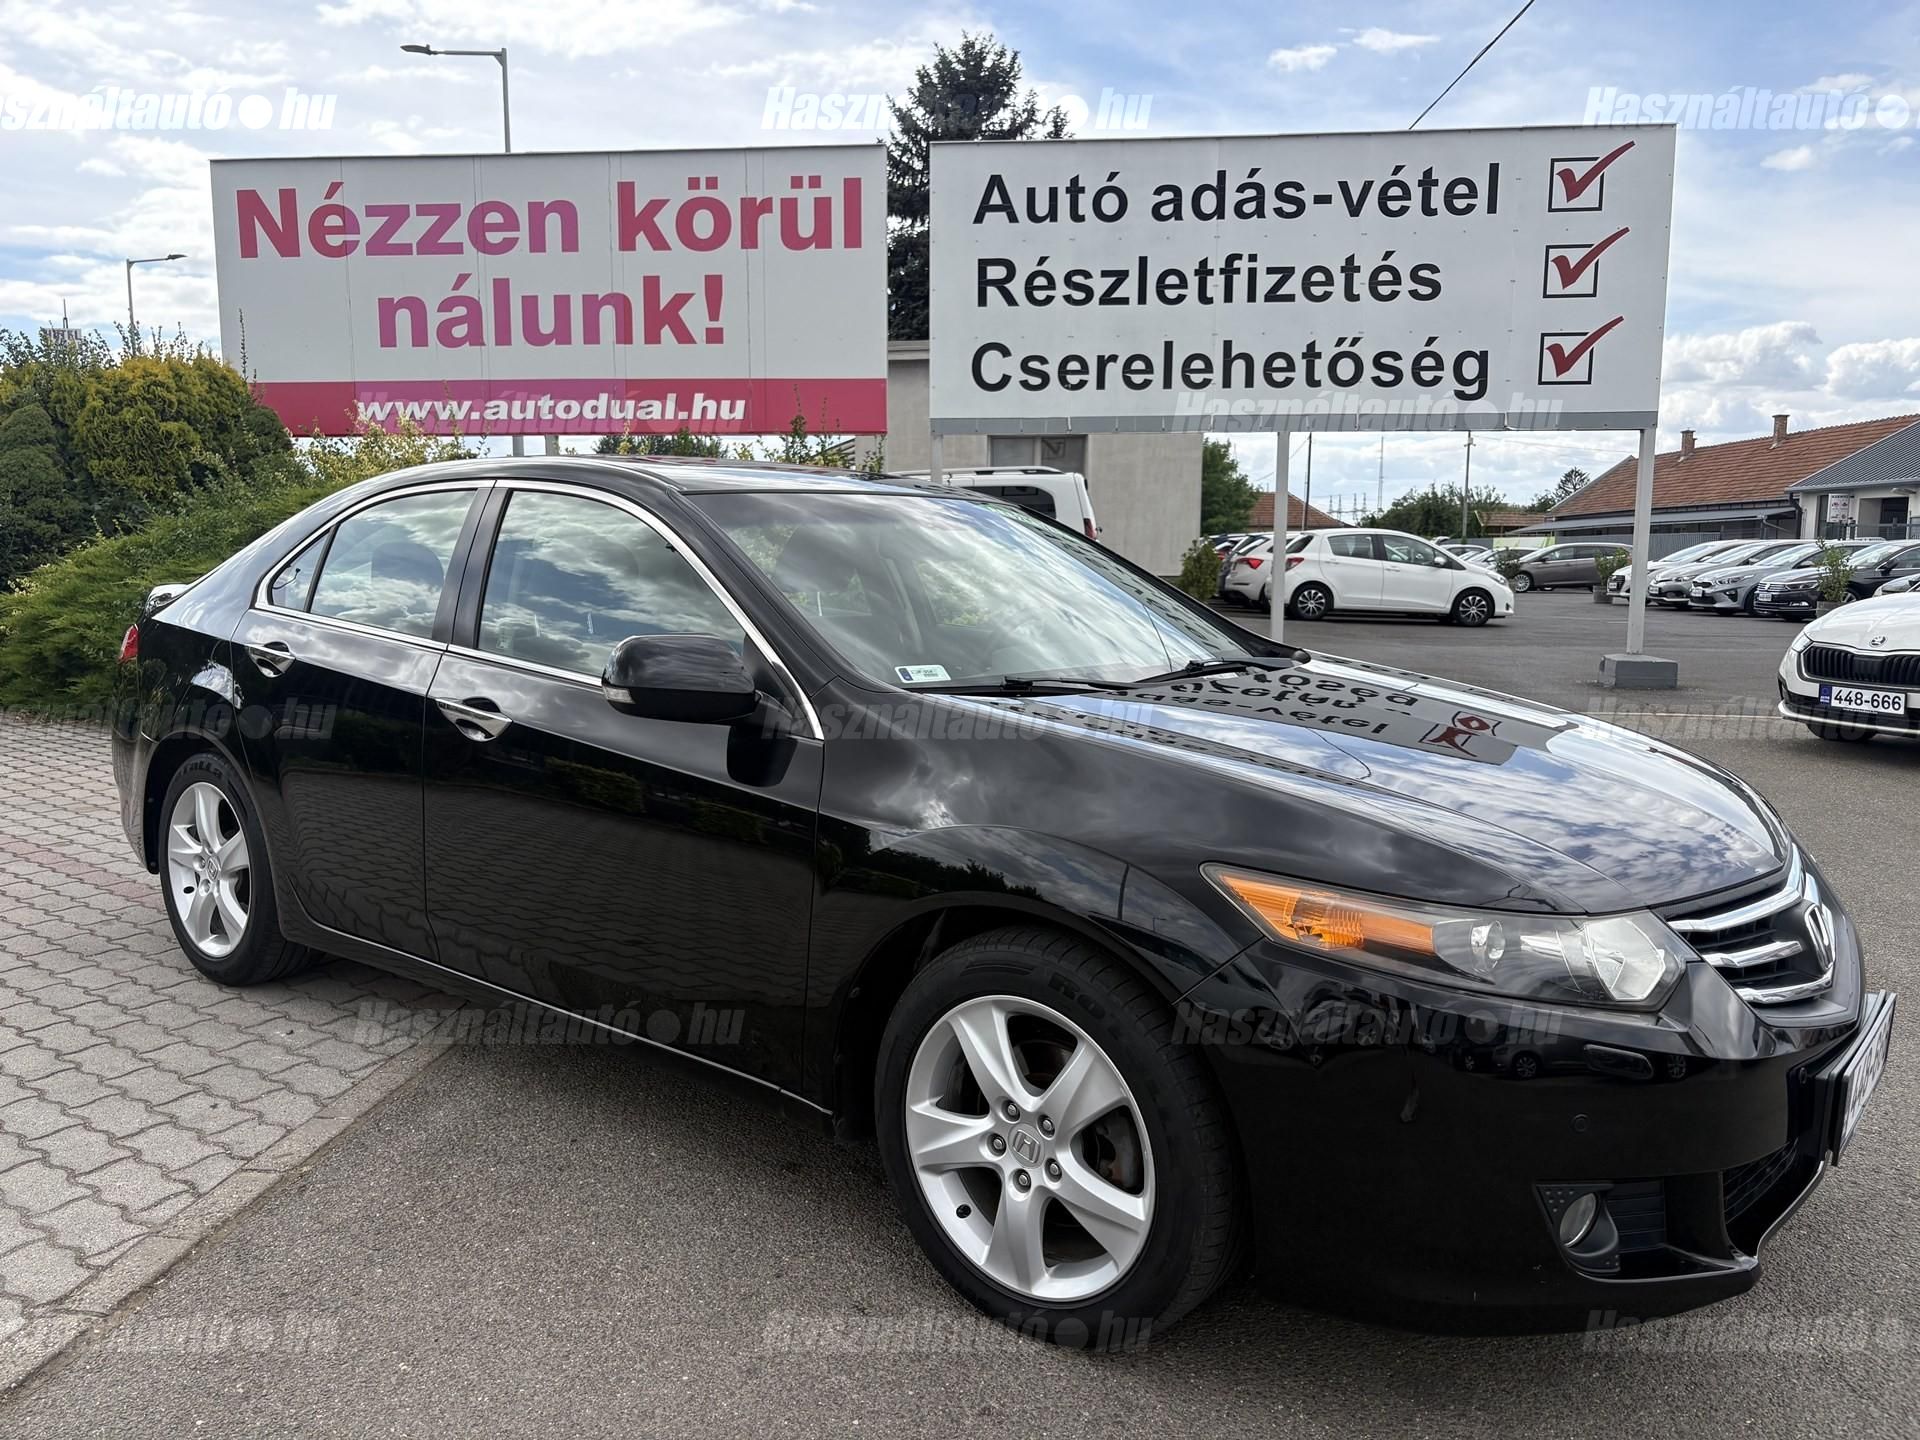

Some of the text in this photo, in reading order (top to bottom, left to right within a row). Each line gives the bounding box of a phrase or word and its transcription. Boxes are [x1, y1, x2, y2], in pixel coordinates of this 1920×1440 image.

[236, 175, 863, 259] Nézzen körül
[972, 161, 1500, 225] Autó adás-vétel
[975, 249, 1443, 308] Részletfizetés
[377, 273, 724, 349] nálunk!
[971, 334, 1491, 400] Cserelehetőség
[356, 391, 746, 421] www.autodual.hu
[1833, 689, 1902, 711] 448-666
